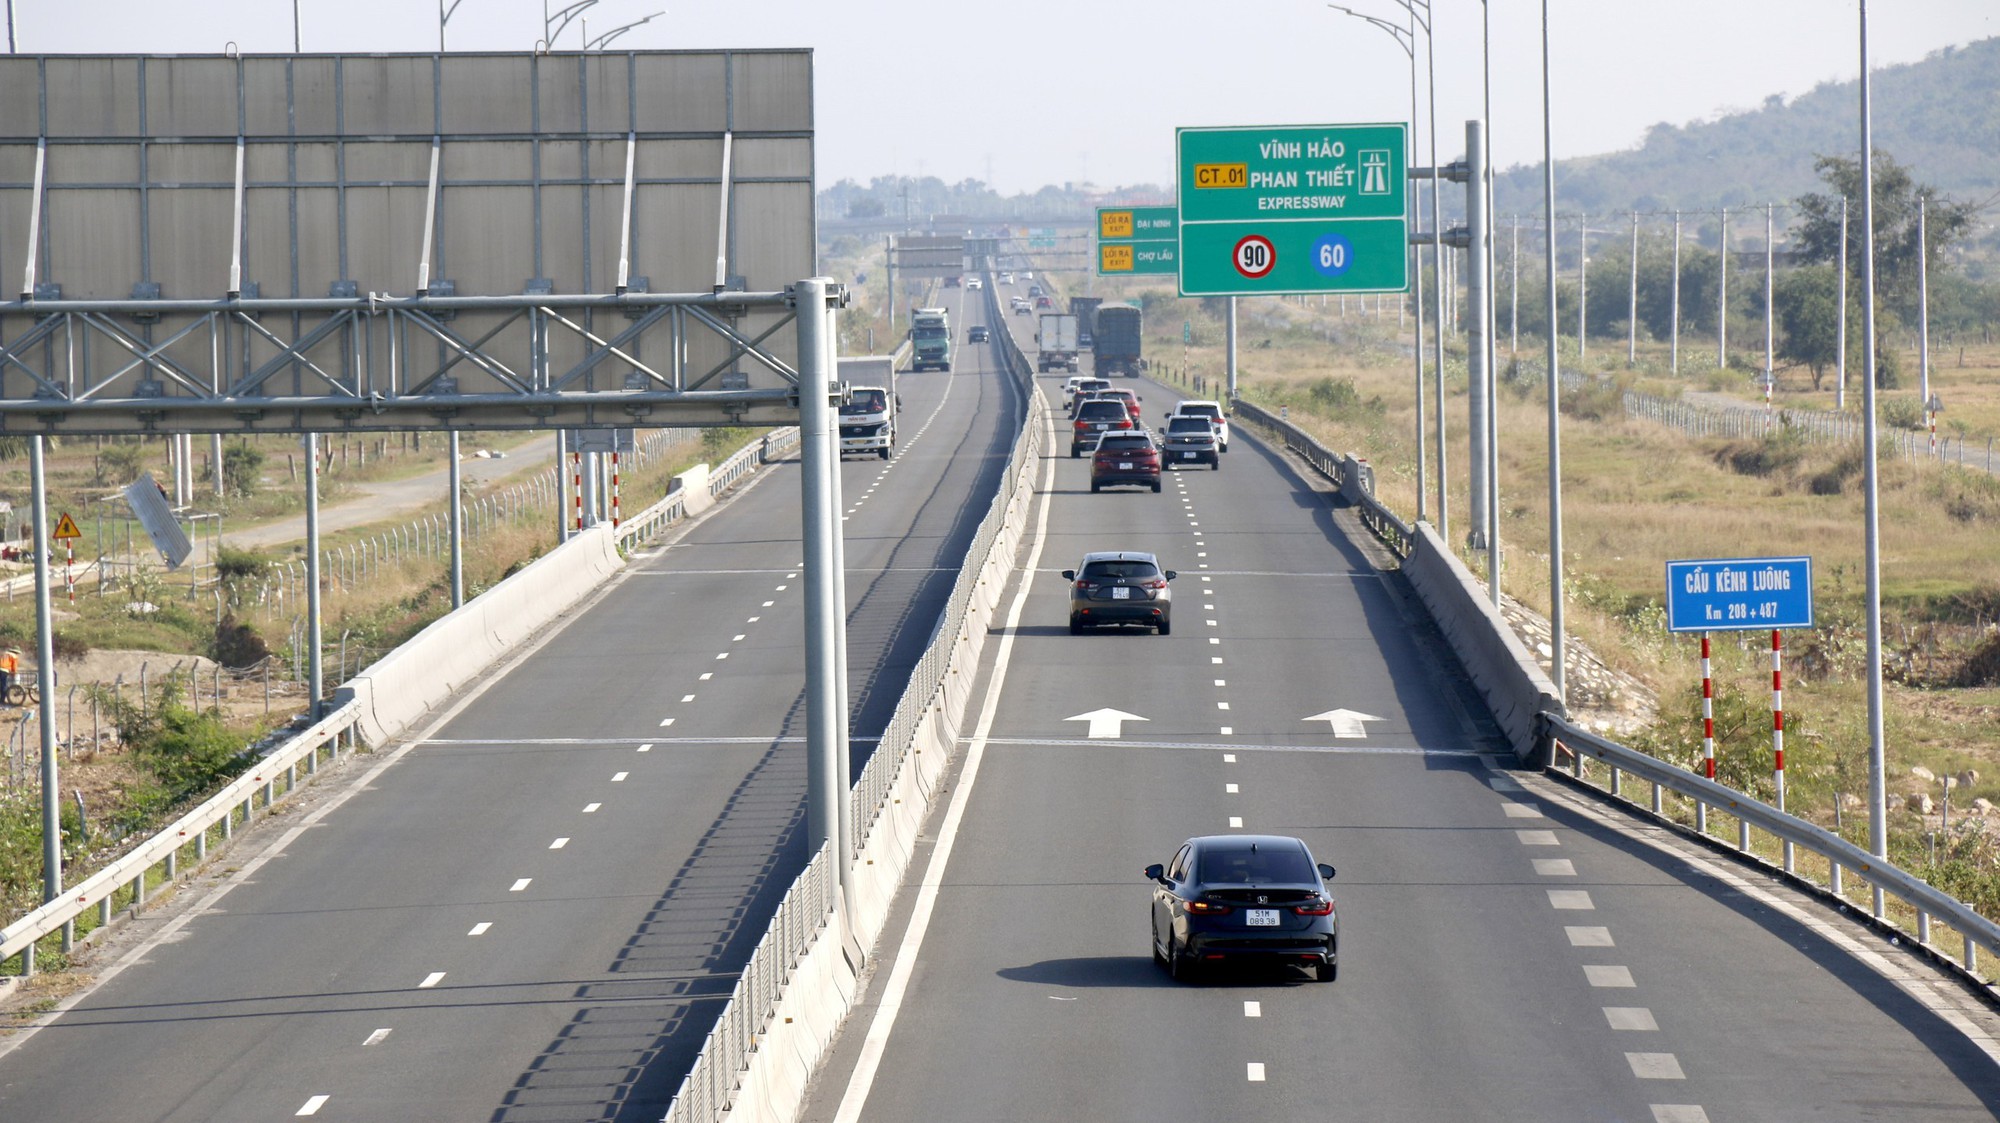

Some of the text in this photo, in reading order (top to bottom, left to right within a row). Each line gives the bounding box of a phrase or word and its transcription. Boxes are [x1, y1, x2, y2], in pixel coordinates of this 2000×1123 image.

[1260, 137, 1345, 159] VĨNH HẢO
[1198, 167, 1244, 184] CT.01
[1250, 163, 1355, 188] PHAN THIẾT
[1258, 195, 1346, 210] EXPRESSWAY
[1119, 217, 1129, 225] RA
[1137, 220, 1172, 230] ĐẠI NINH
[1119, 250, 1129, 258] RA
[1137, 251, 1156, 263] CHỢ
[1243, 245, 1265, 268] 90
[1319, 244, 1344, 268] 60
[1686, 566, 1790, 594] CẦU KÊNH LUÔNG
[1705, 602, 1777, 620] Km 208 + 487
